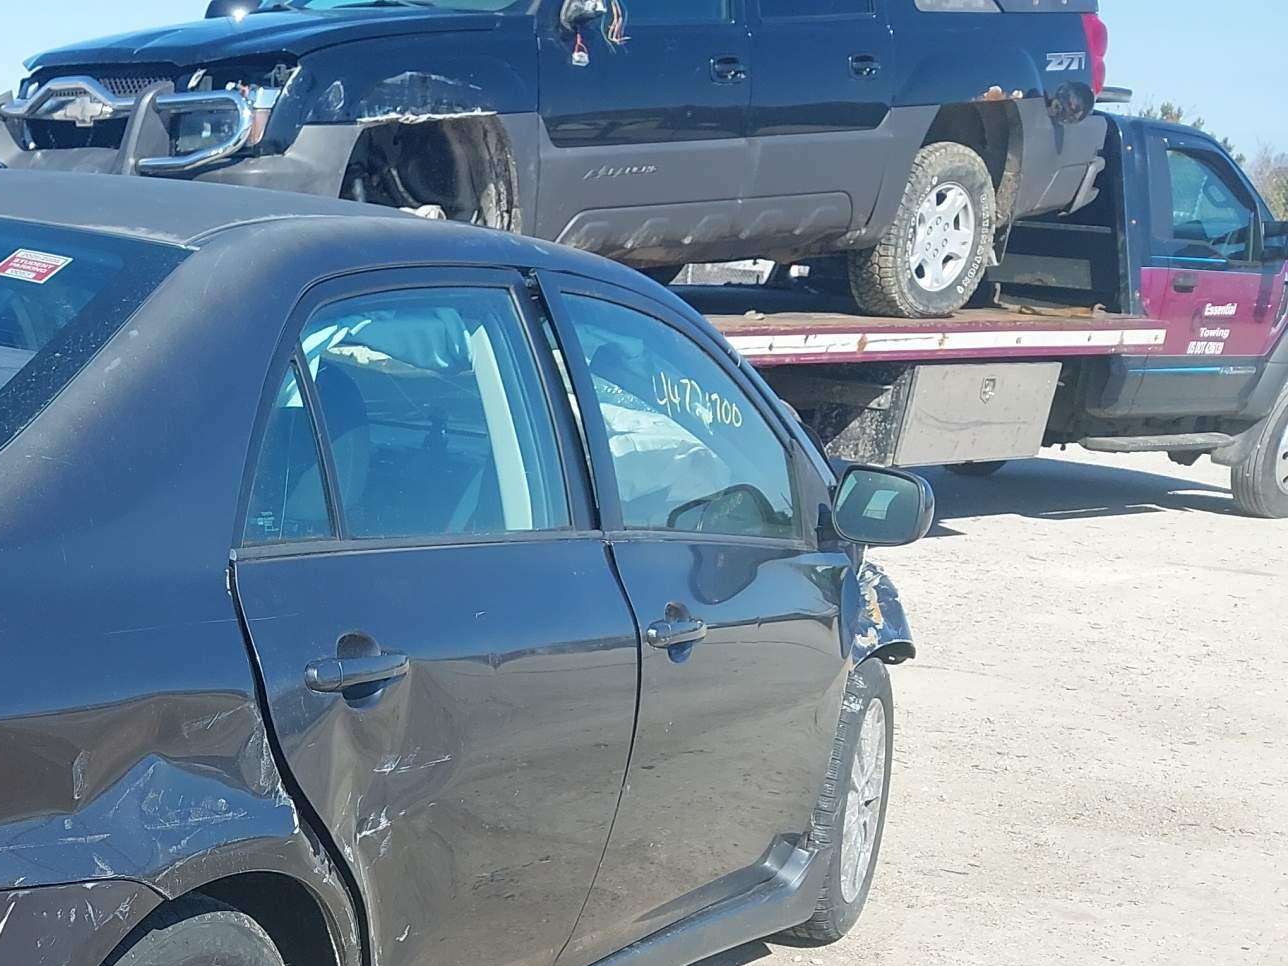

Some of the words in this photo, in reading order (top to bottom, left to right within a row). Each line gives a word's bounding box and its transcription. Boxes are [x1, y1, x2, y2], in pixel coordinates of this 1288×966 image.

[1046, 52, 1086, 71] Z71
[8, 262, 48, 273] PARKING
[12, 258, 55, 269] STUDENT
[1204, 303, 1237, 315] Essential
[1199, 327, 1231, 339] Towing
